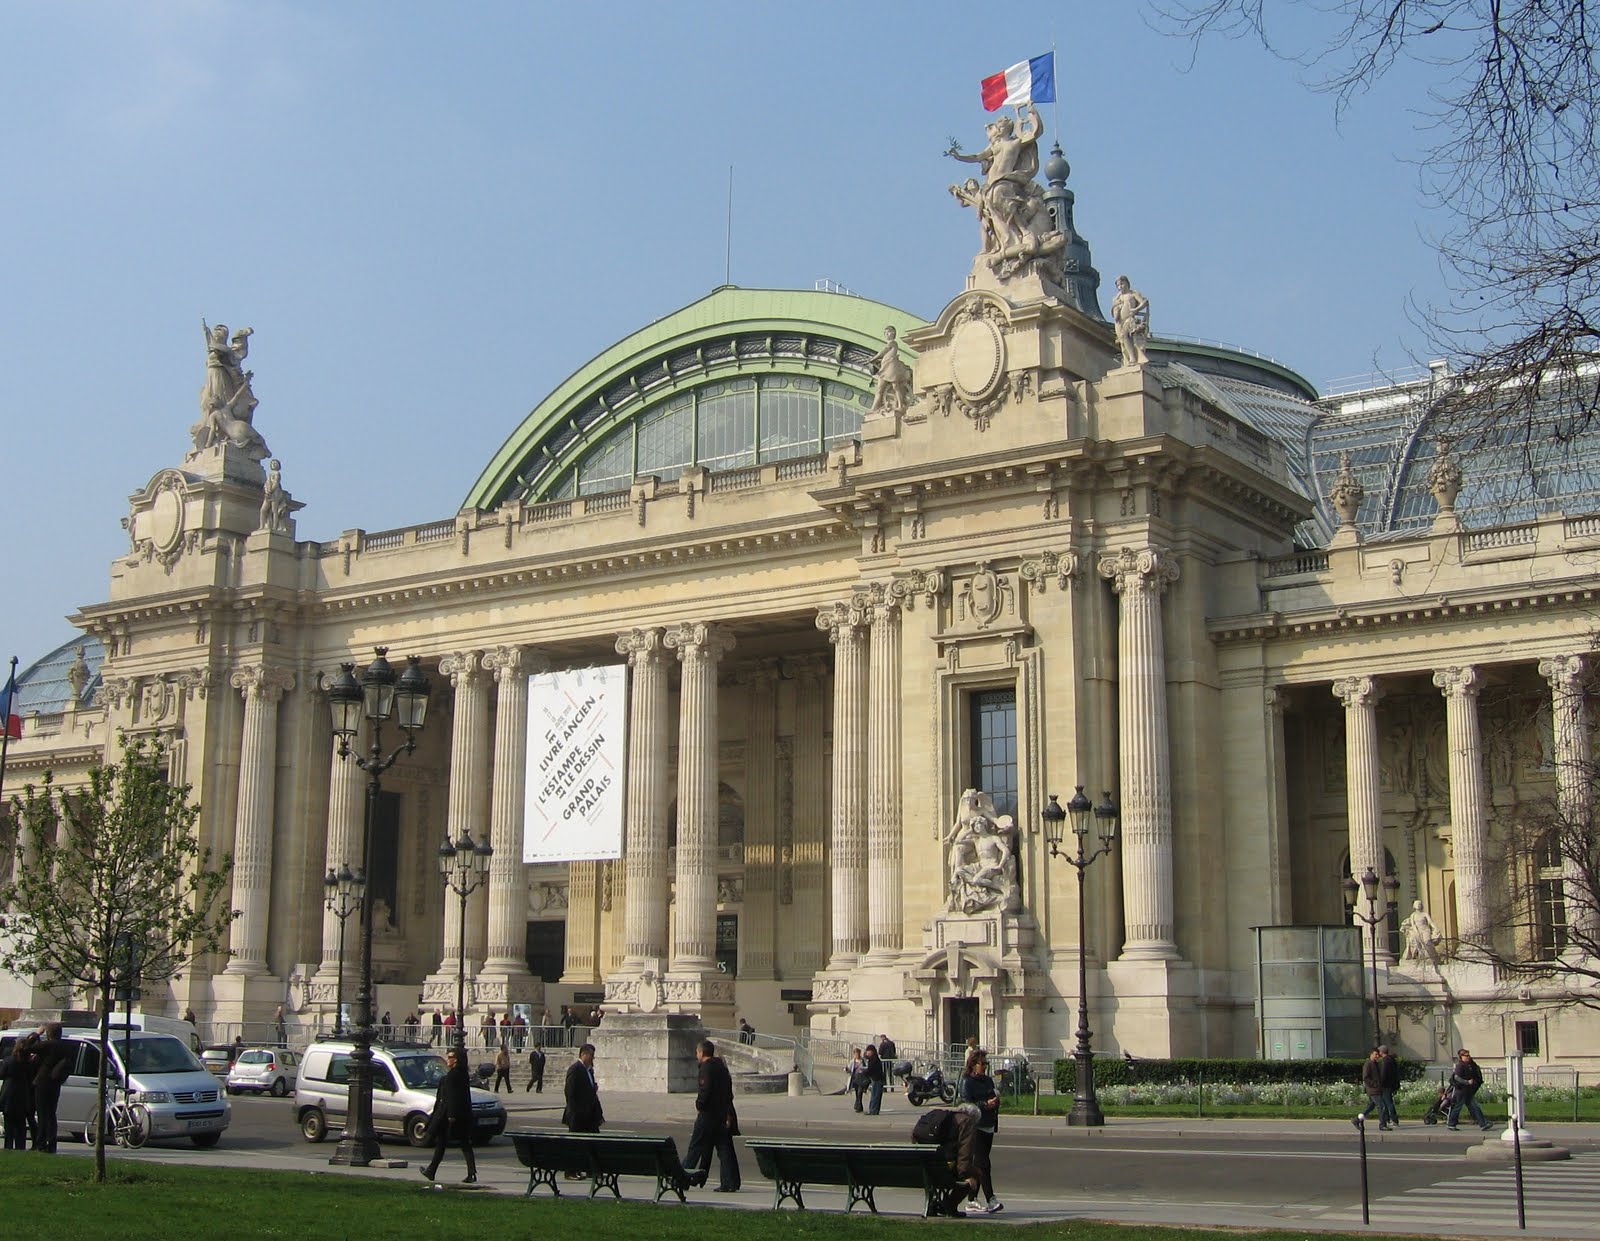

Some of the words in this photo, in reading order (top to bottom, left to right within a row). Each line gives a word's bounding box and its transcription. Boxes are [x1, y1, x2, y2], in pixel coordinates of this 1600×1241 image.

[539, 740, 564, 772] LIVRE
[563, 695, 596, 742] ANCIEN
[545, 729, 557, 744] LE
[538, 745, 583, 804] L'ESTAMPE
[564, 772, 576, 788] LE
[573, 733, 606, 774] DESSIN
[555, 785, 567, 800] ET
[563, 778, 595, 820] GRAND
[579, 775, 612, 817] PALAIS
